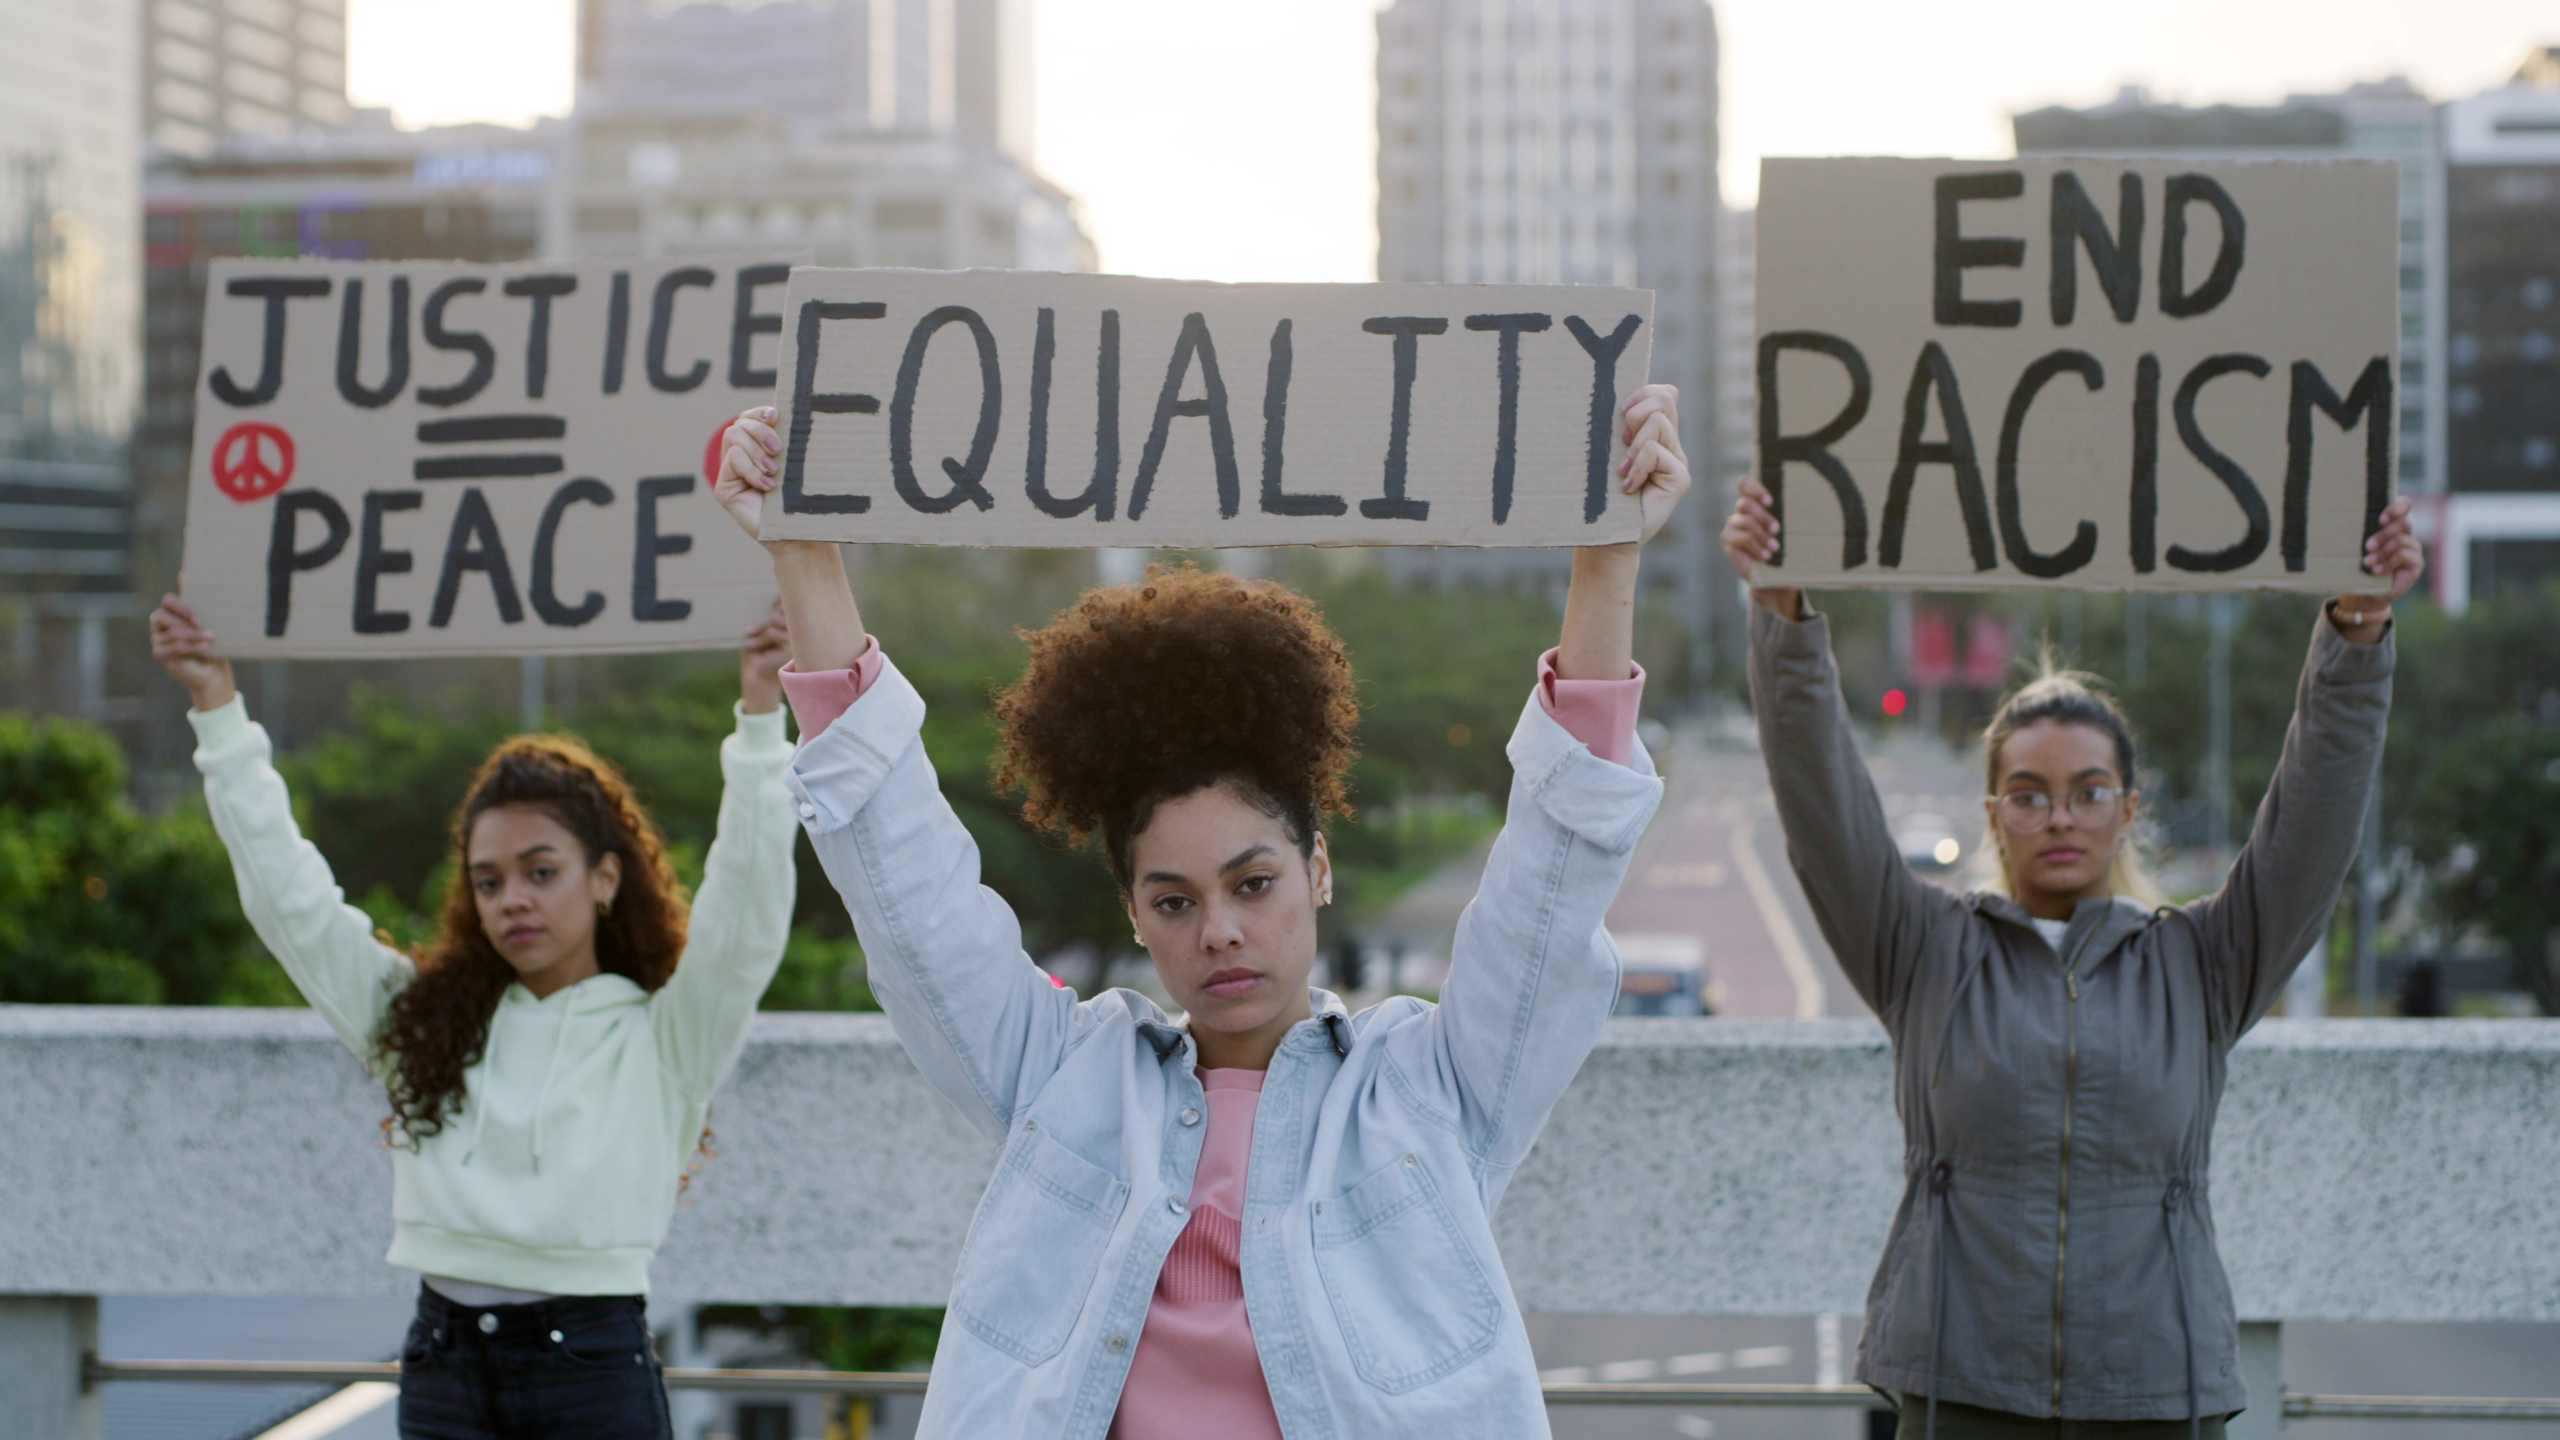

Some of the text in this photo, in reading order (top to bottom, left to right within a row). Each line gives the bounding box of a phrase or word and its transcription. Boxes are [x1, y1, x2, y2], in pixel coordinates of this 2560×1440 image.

[1933, 171, 2247, 328] END
[208, 264, 792, 409] JUSTICE
[781, 299, 1643, 525] EQUALITY
[1756, 330, 2393, 578] RACISM
[265, 475, 696, 638] PEACE
